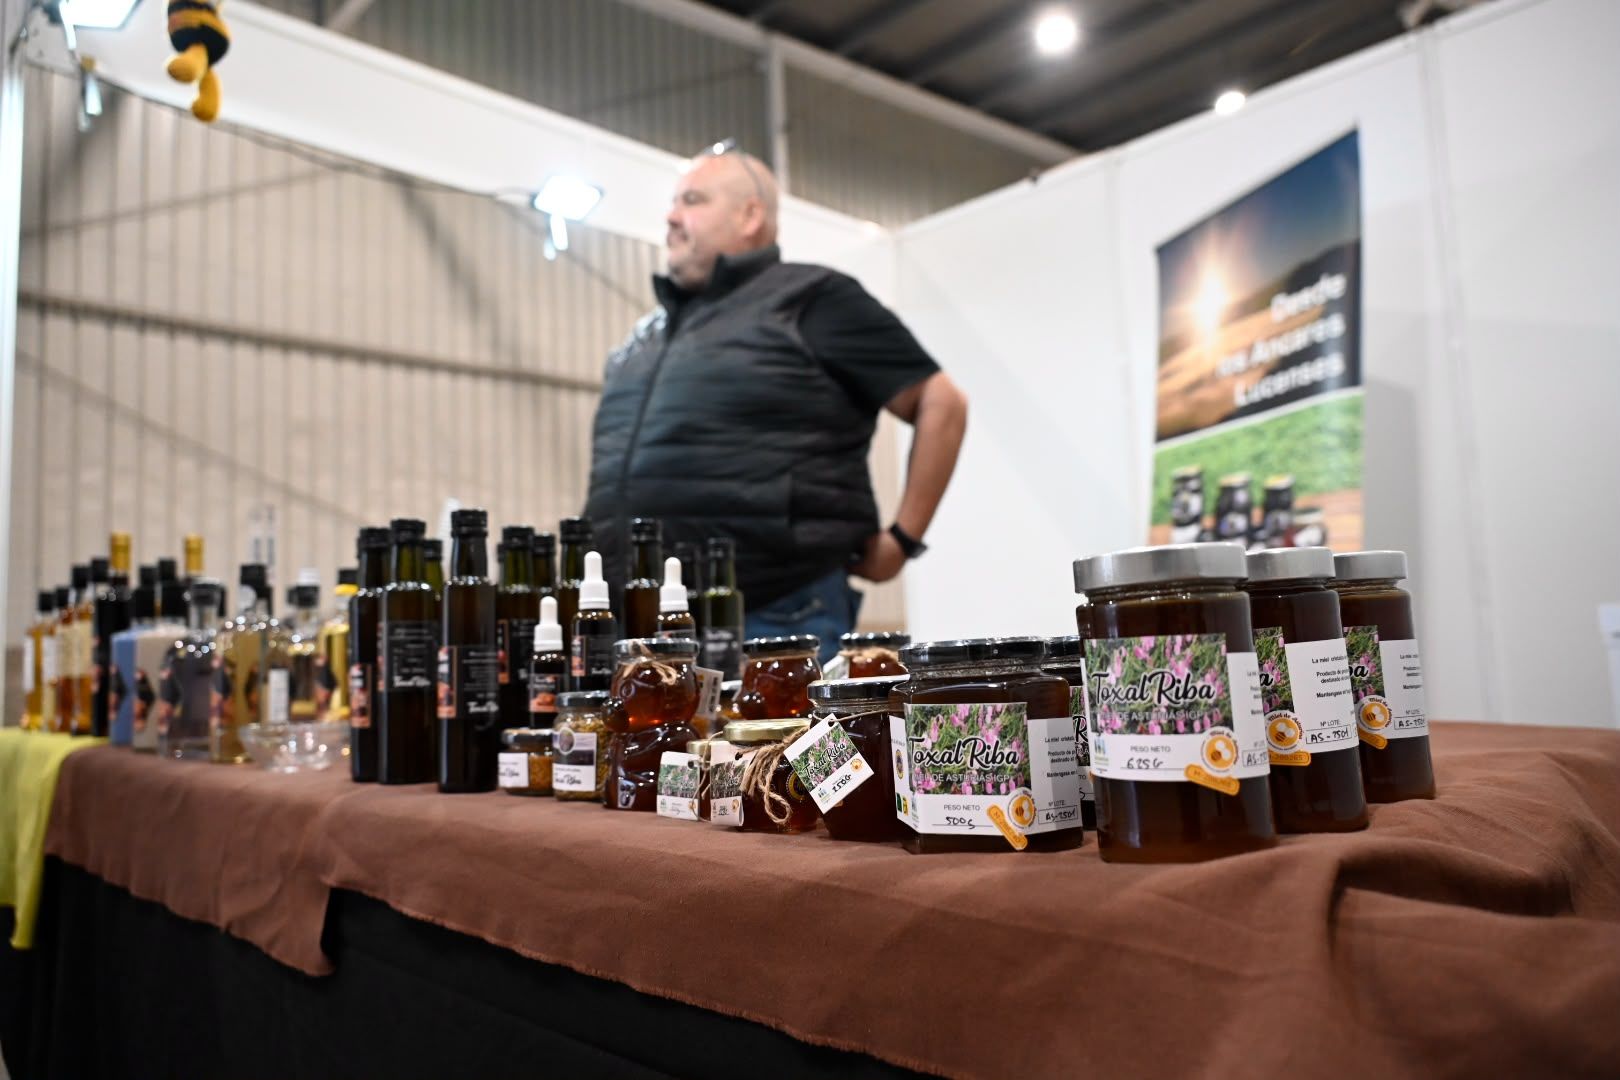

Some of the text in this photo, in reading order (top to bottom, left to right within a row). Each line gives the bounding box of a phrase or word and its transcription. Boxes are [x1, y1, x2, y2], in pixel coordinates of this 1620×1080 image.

[1090, 671, 1149, 705] Toxal
[1147, 670, 1217, 706] Riba
[908, 736, 1020, 770] Toxal Riba
[1130, 744, 1171, 753] PESO NETO
[933, 773, 944, 782] DE
[945, 773, 992, 782] ASTURIAS
[943, 803, 981, 812] PESO NETO
